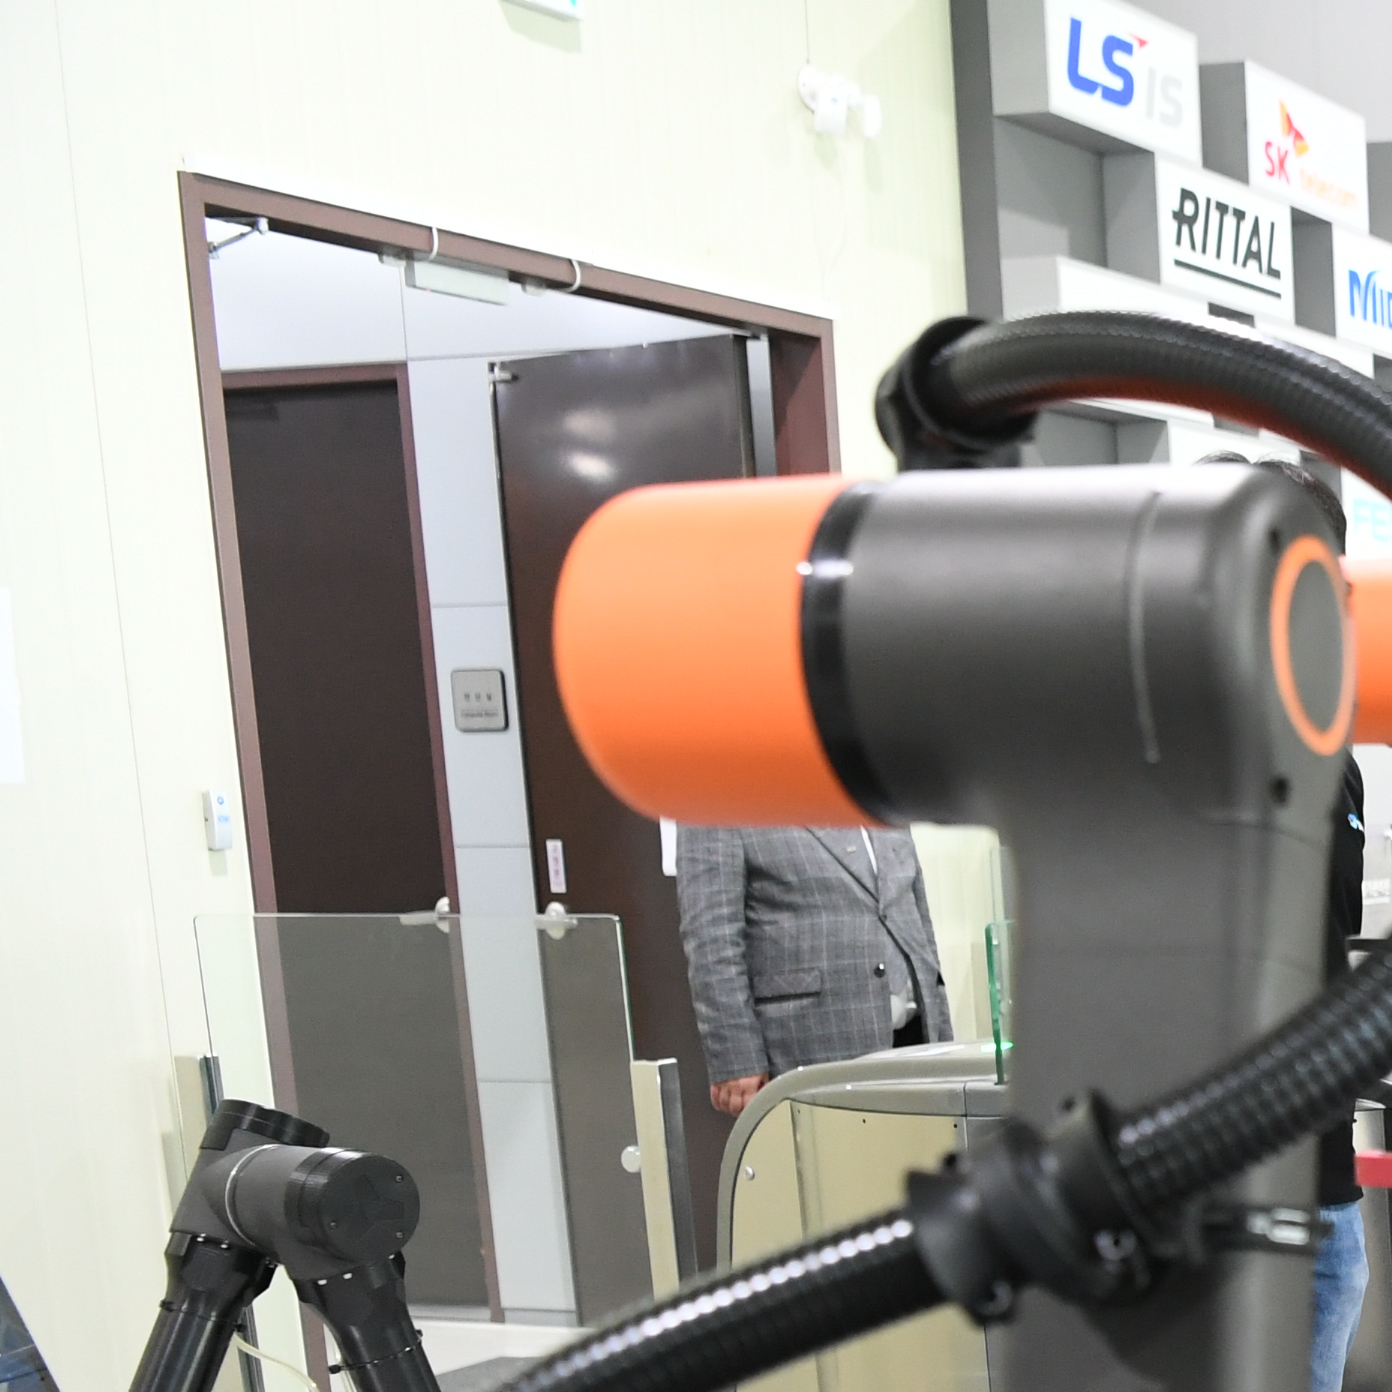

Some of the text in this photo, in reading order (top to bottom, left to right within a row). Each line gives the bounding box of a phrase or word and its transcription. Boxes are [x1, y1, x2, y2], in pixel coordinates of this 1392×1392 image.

[1067, 16, 1184, 128] LS IS
[1264, 140, 1359, 211] SK telecom
[1171, 187, 1282, 280] RITTAL
